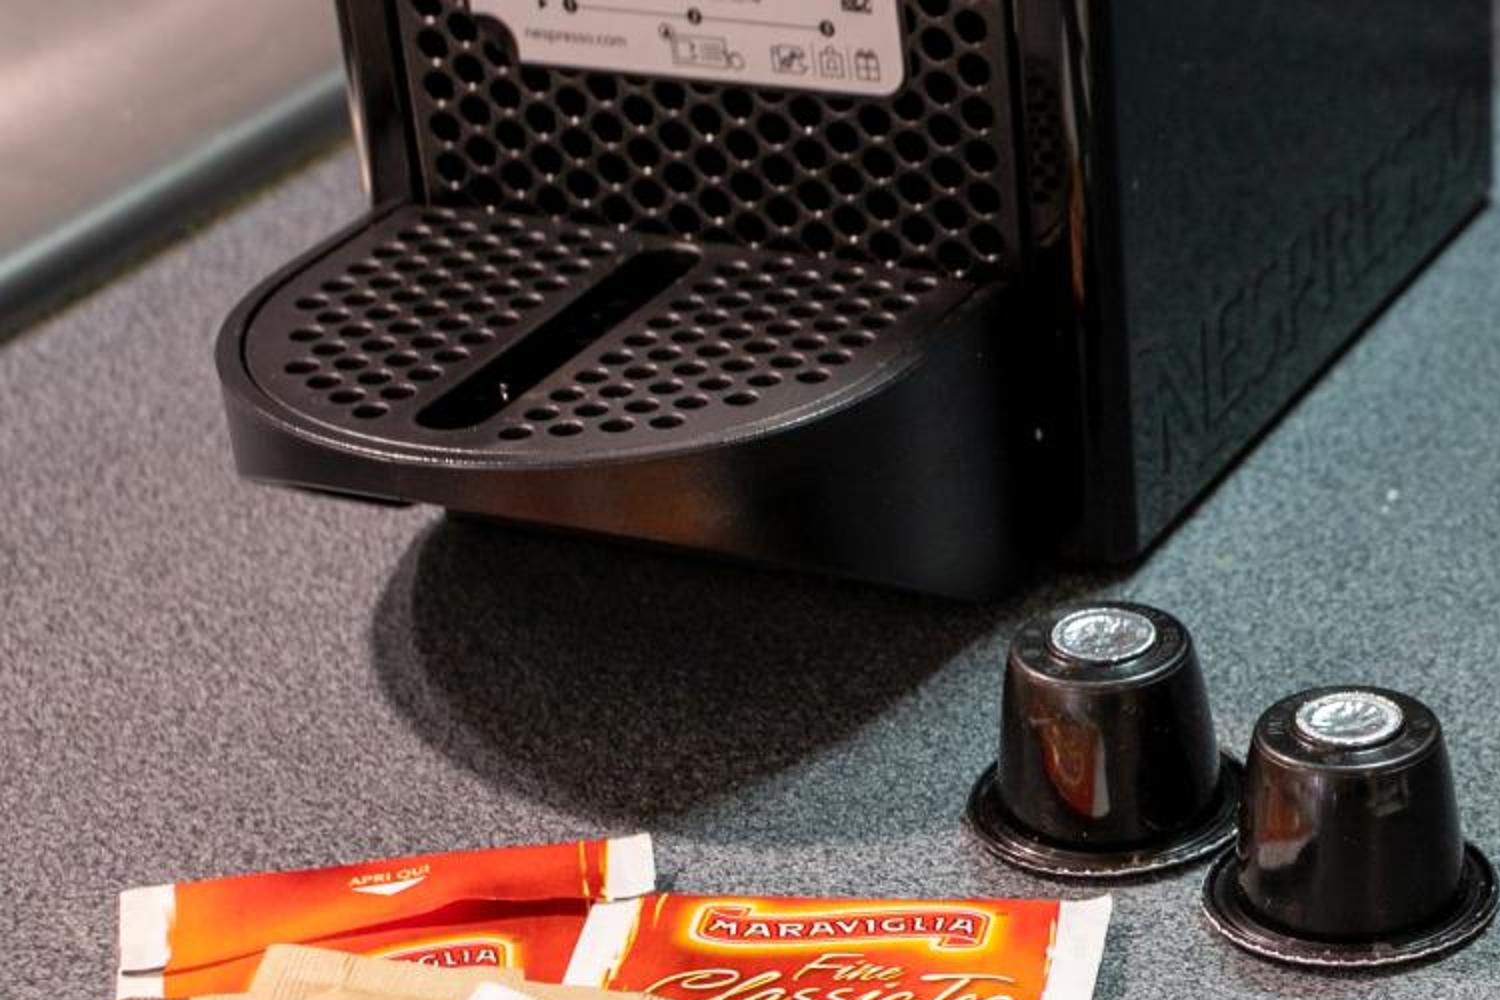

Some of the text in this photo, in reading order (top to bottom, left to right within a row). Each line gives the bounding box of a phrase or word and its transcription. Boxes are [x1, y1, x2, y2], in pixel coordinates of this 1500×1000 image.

[350, 872, 391, 887] APRI
[707, 916, 976, 939] MARAVIGLIA
[792, 953, 905, 983] Fine
